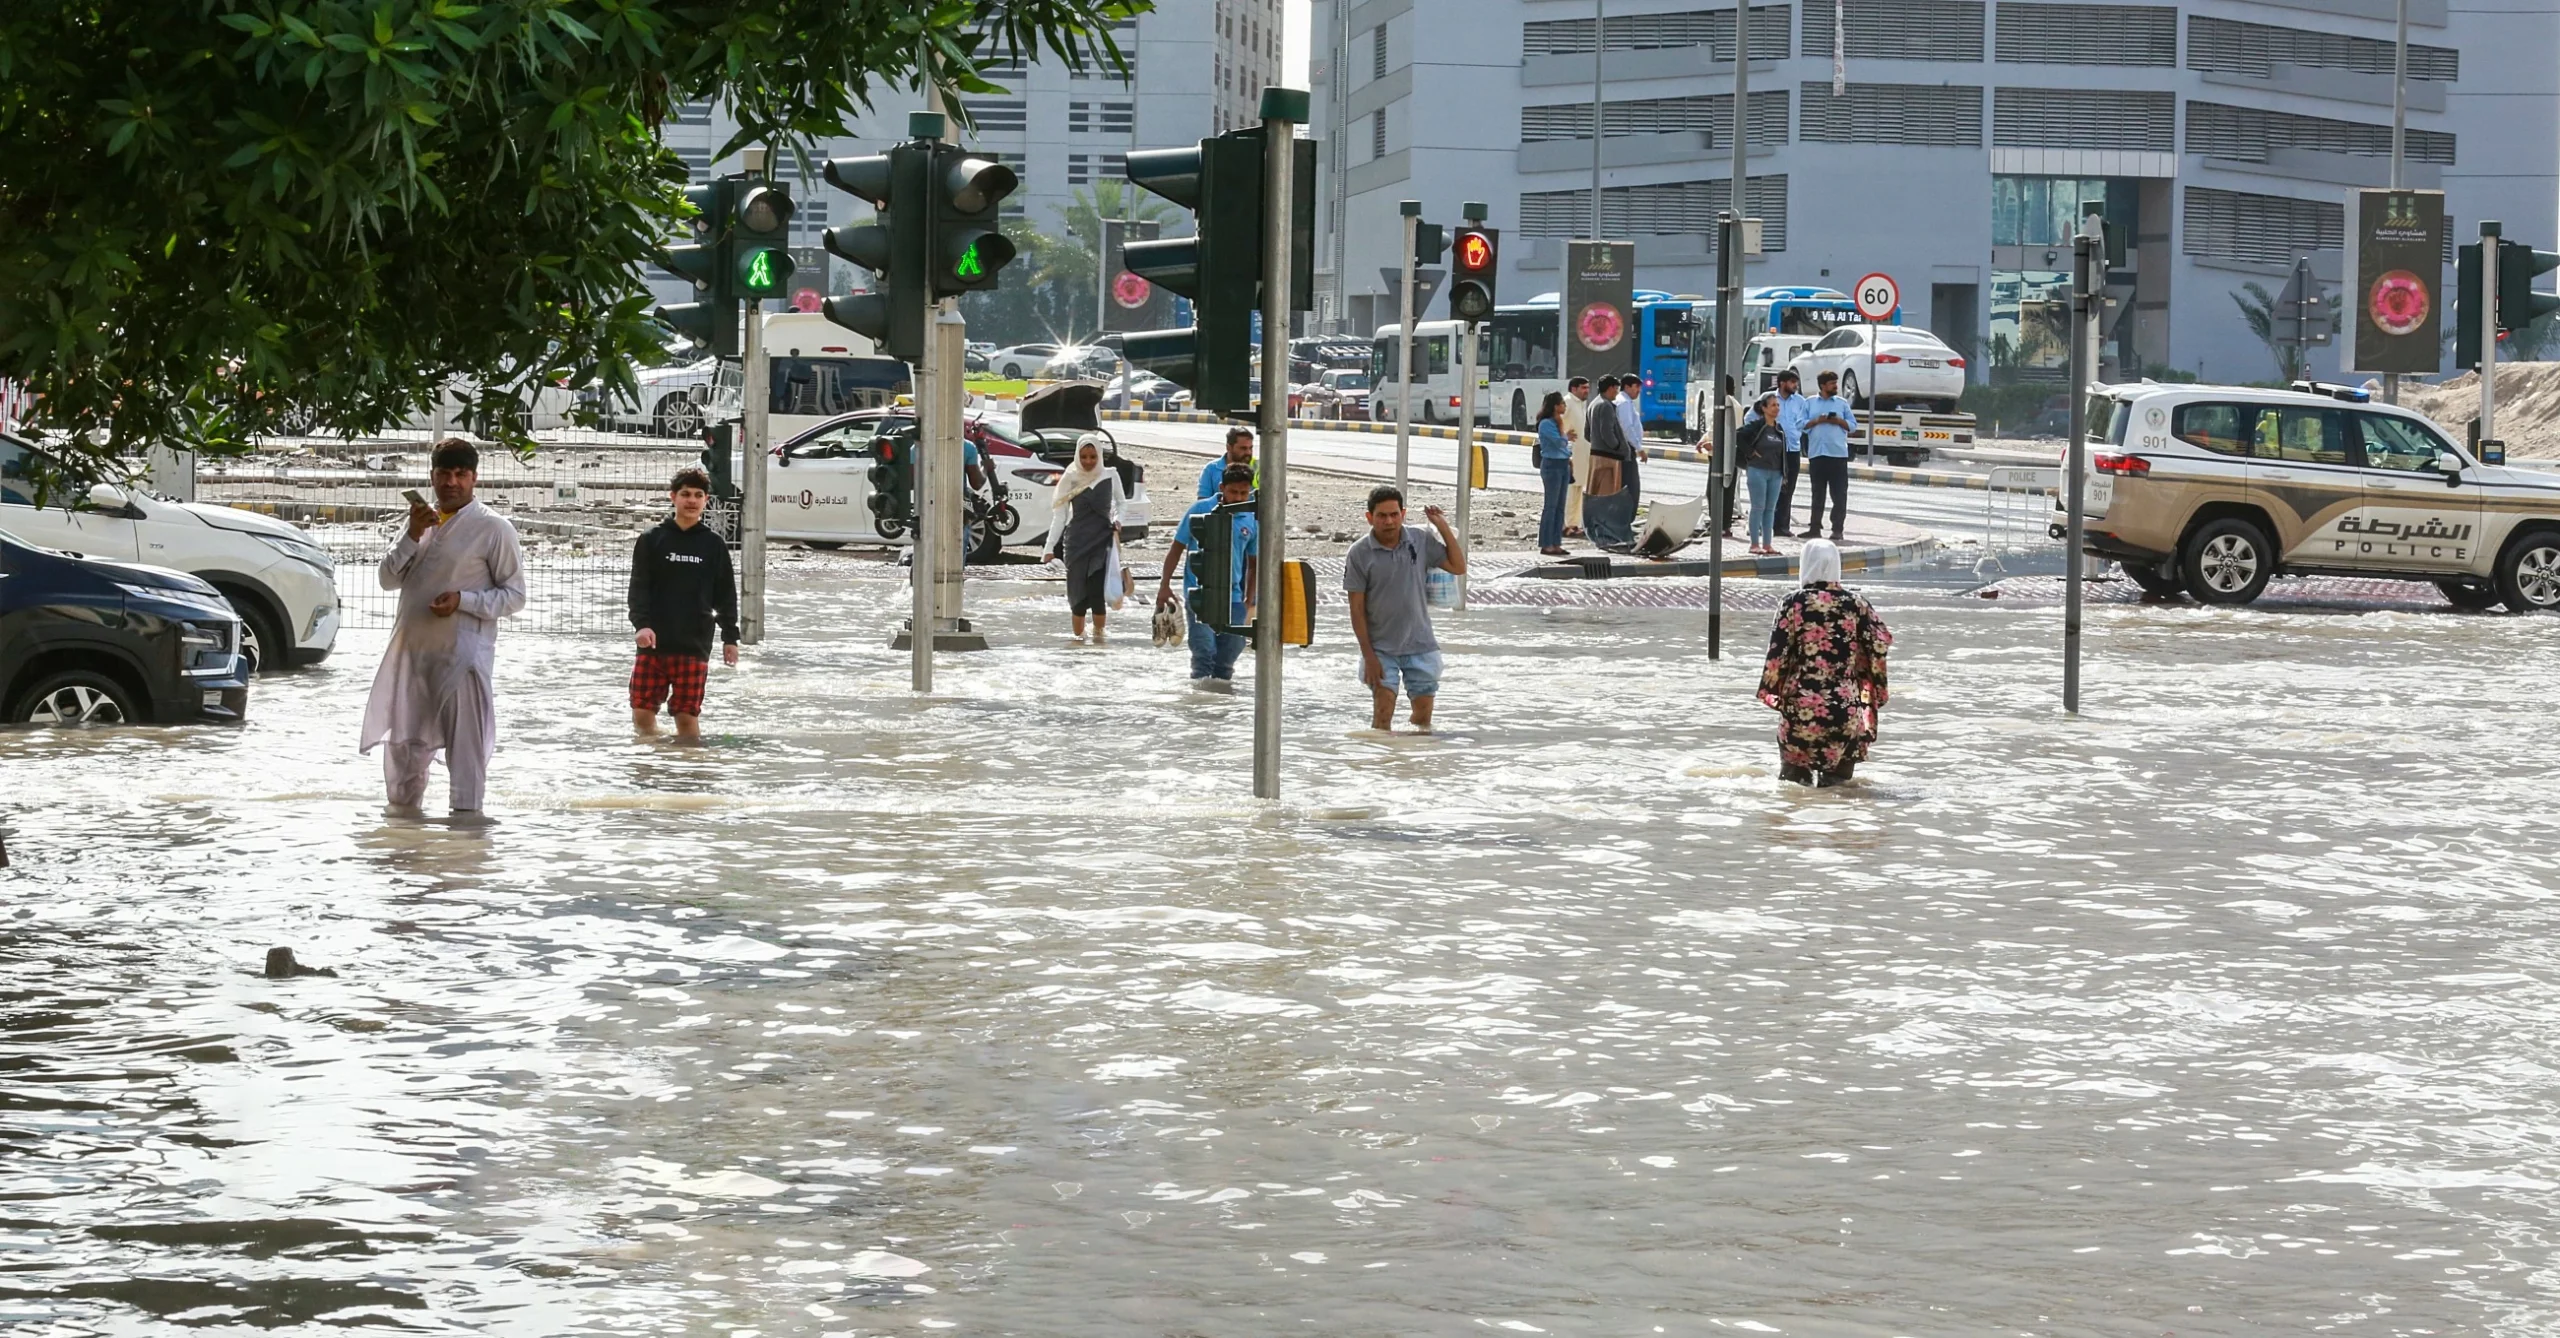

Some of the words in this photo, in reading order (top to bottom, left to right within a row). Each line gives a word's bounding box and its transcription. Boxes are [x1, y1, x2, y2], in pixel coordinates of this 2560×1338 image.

[1864, 288, 1889, 305] 60
[1812, 310, 1818, 321] 9
[1822, 310, 1836, 322] Via
[1836, 311, 1846, 322] Al
[2143, 436, 2168, 449] 901
[2008, 471, 2036, 483] POLICE
[770, 494, 786, 503] UNION
[787, 495, 797, 504] TAXI
[1014, 492, 1023, 500] 52
[1024, 492, 1033, 500] 52
[2093, 489, 2107, 502] 901
[2337, 516, 2472, 541] الشرطة
[2335, 540, 2466, 559] POLICE
